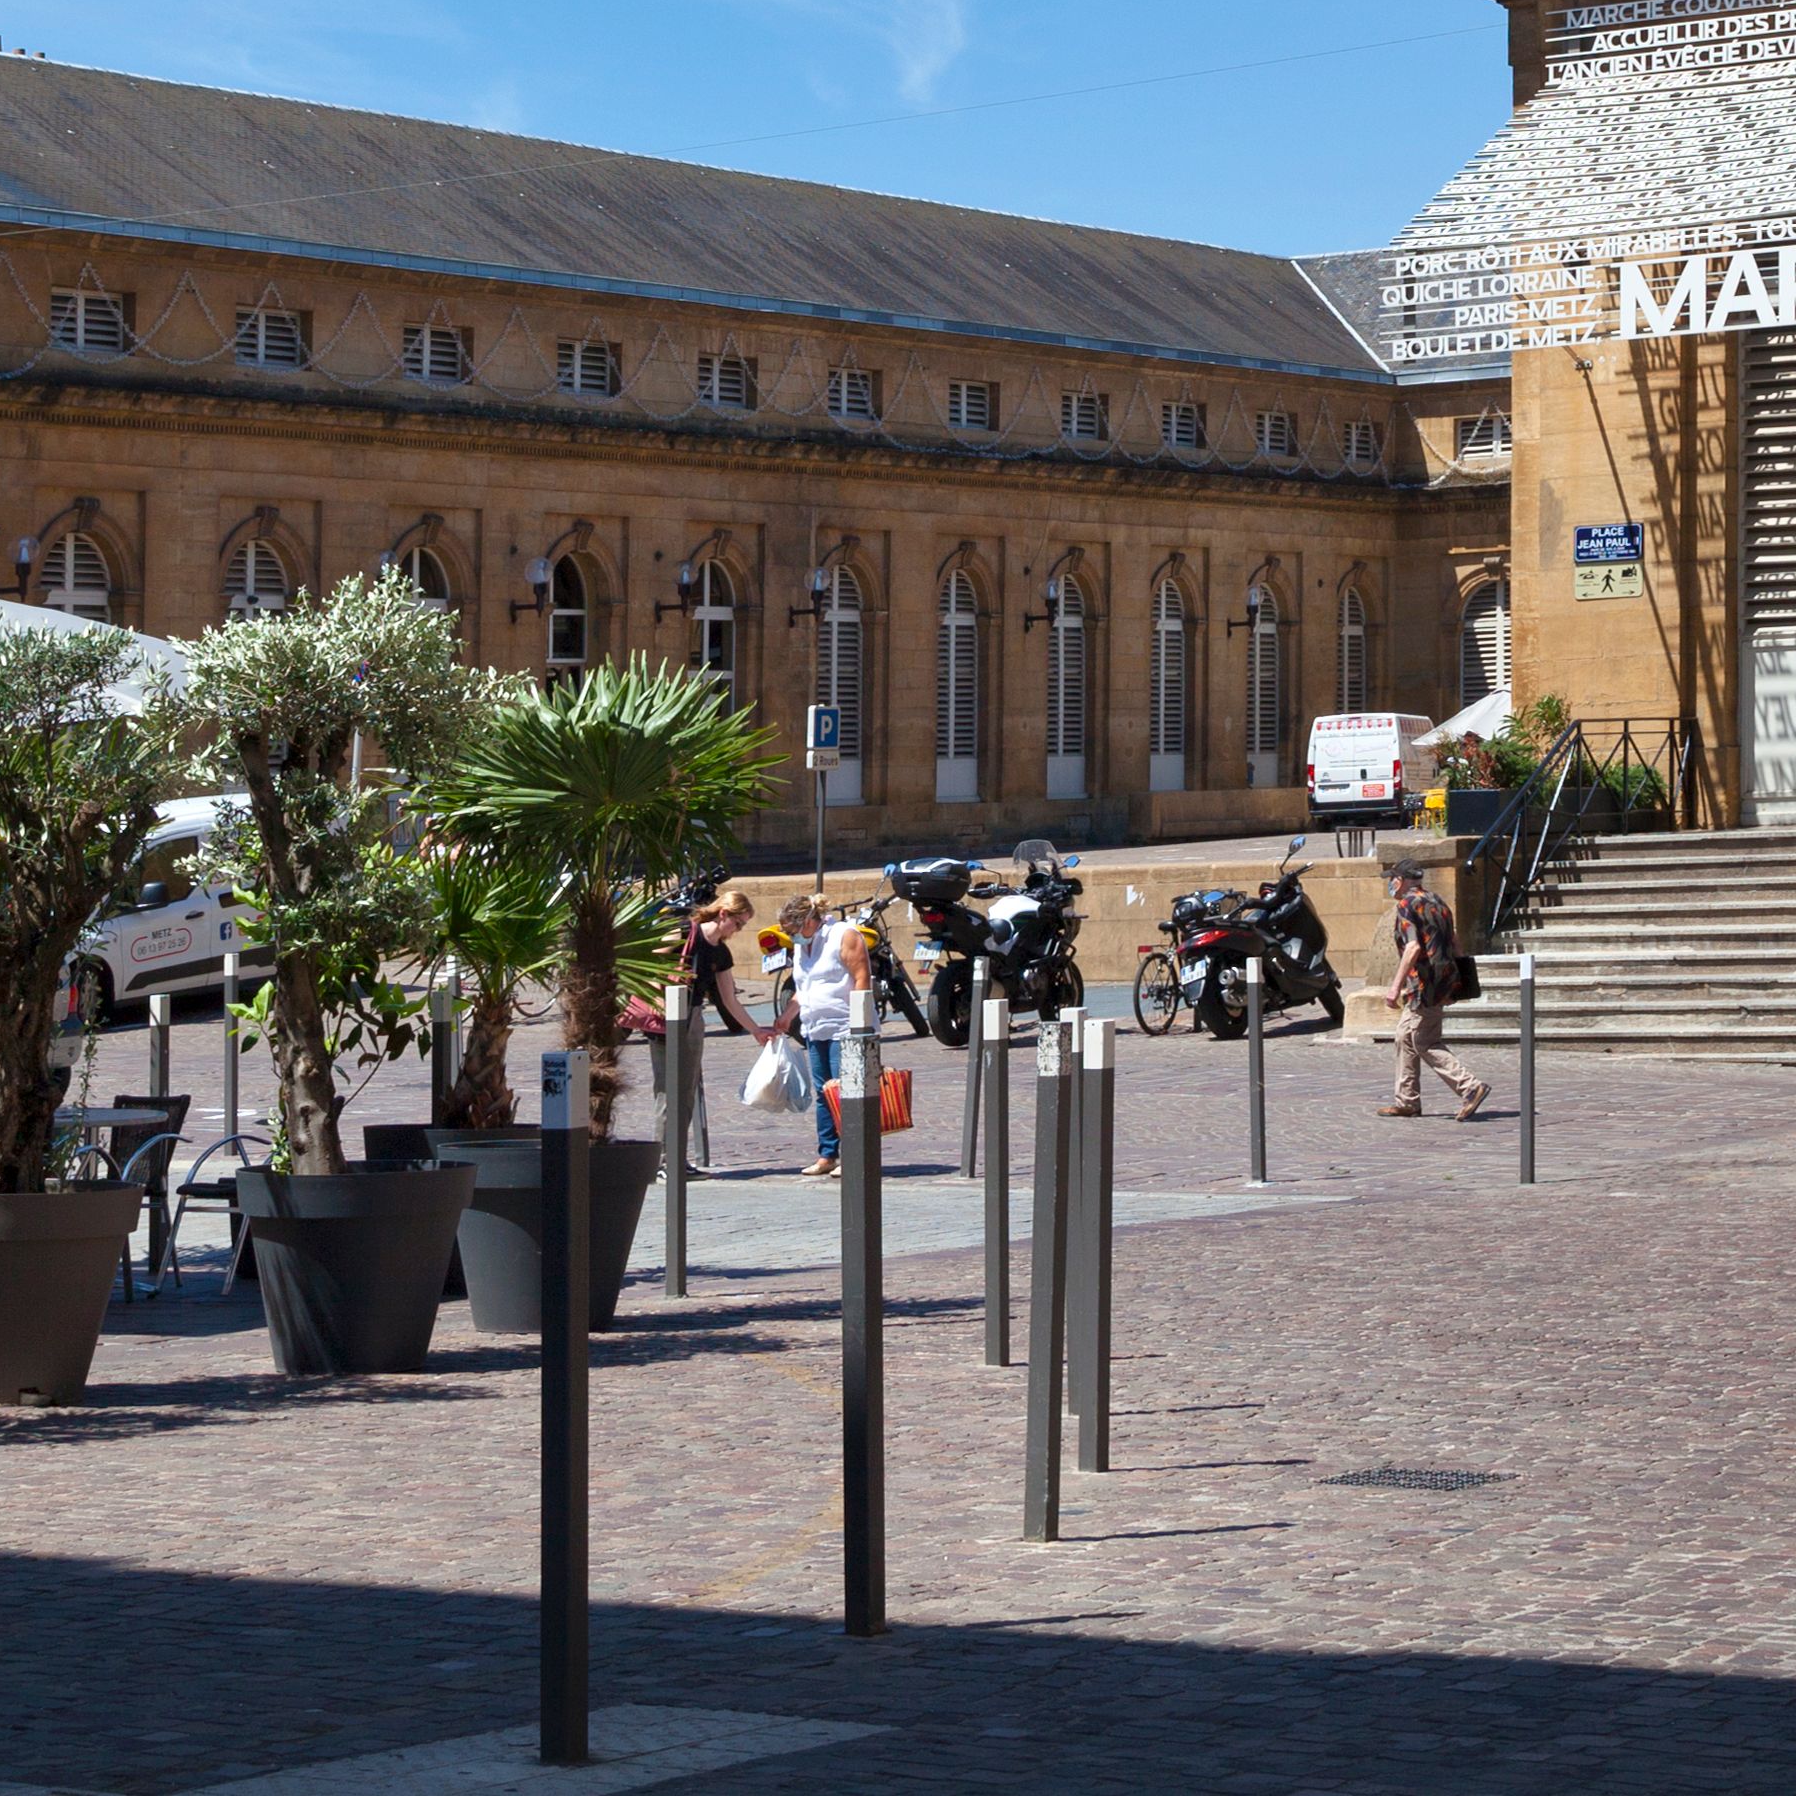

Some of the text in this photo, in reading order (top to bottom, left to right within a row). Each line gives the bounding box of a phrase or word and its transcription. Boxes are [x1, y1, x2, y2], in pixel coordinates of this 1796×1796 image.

[1591, 18, 1717, 52] ACCUEILLIR
[1724, 12, 1768, 36] DES
[1547, 52, 1651, 85] L'ANCIEN
[1655, 39, 1742, 72] ÉVÊCHÉ
[1395, 251, 1460, 277] PORC
[1466, 243, 1520, 270] RÔTI
[1527, 239, 1578, 264] AUX
[1587, 223, 1743, 259] MIRABELLES,
[1382, 268, 1601, 306] QUICHE LORRAINE,
[1455, 295, 1601, 326] PARIS-METZ,
[1392, 323, 1601, 361] BOULET DE METZ,
[1577, 539, 1603, 549] JEAN
[1606, 538, 1631, 547] PAUL
[1591, 527, 1625, 537] PLACE
[821, 715, 833, 741] P
[819, 754, 838, 766] Roues
[152, 928, 172, 940] METZ
